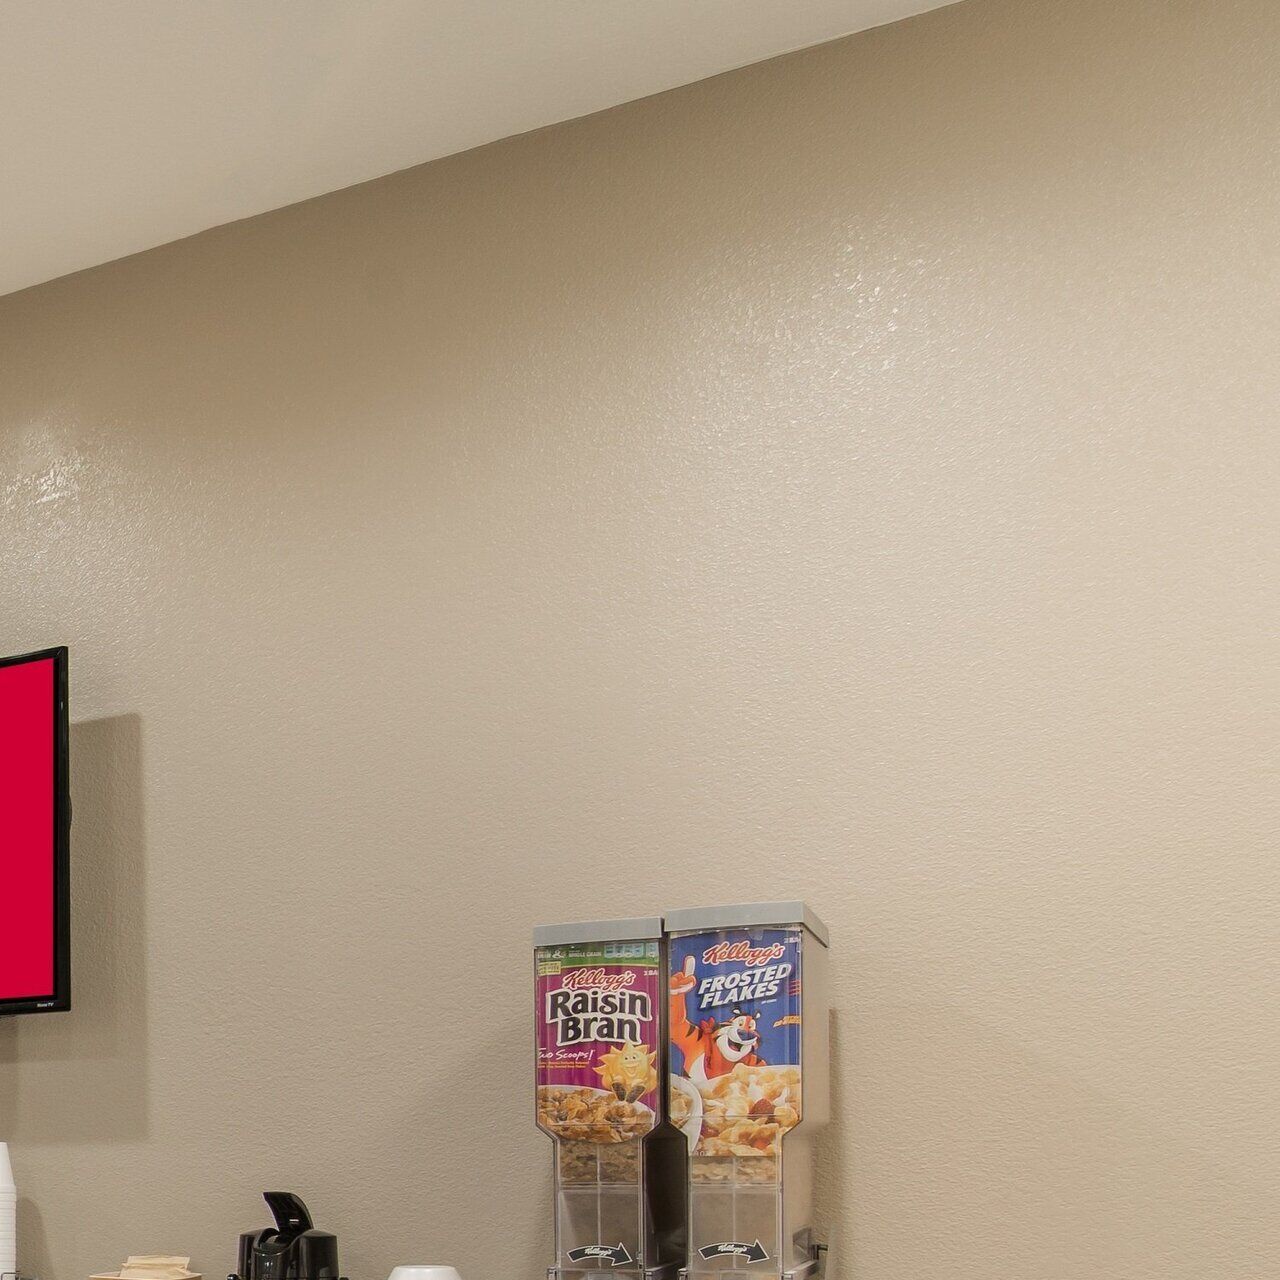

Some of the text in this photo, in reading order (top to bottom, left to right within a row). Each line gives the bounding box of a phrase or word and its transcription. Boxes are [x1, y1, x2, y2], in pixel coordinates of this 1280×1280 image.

[702, 941, 785, 967] Kellogg's
[562, 968, 636, 991] Kellogg's
[698, 963, 792, 995] FROSTED
[548, 989, 650, 1021] Raisin
[700, 980, 780, 1009] FLAKES
[558, 1015, 640, 1043] Bran
[556, 1049, 594, 1061] Scoops!
[584, 1244, 612, 1256] Kellogg's
[717, 1243, 748, 1255] Kellogg's
